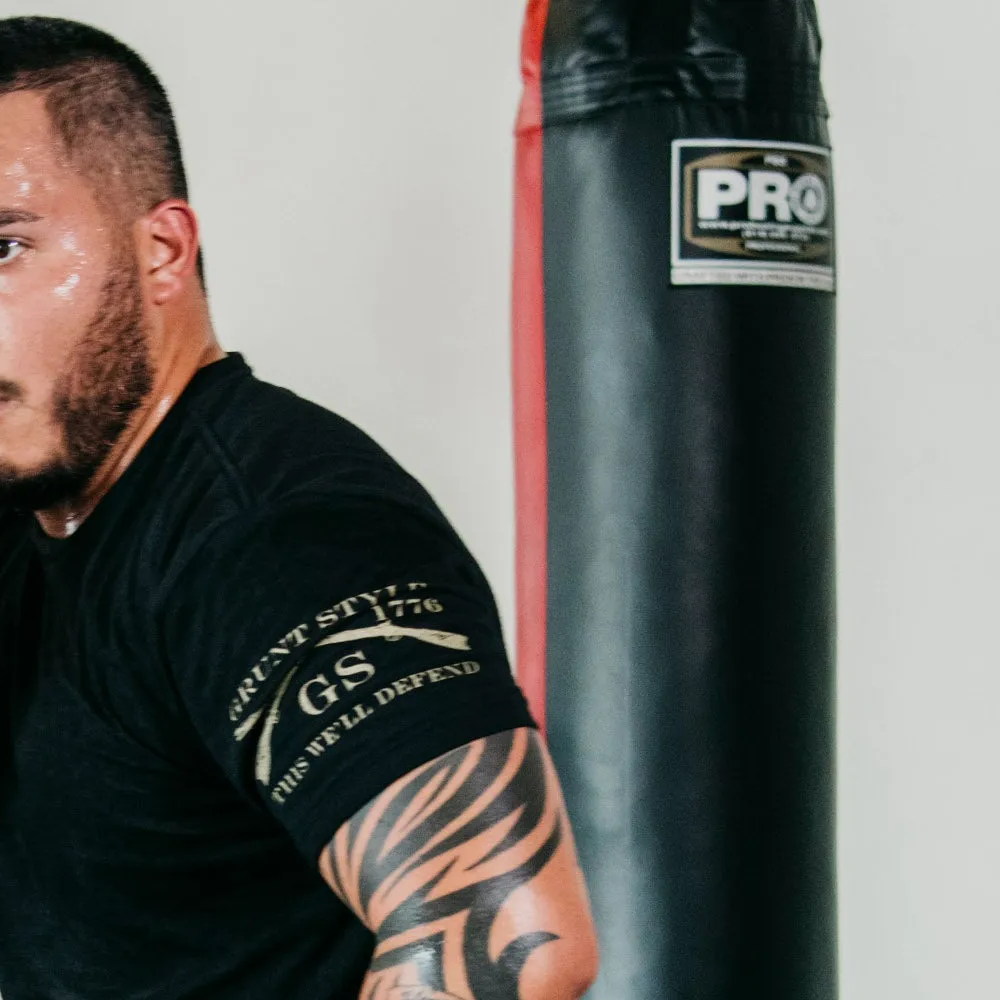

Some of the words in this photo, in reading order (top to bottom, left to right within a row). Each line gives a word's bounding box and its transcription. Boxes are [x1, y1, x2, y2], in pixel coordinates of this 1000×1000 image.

[697, 168, 827, 226] PRO
[370, 598, 444, 622] 1776
[297, 650, 376, 716] GS
[271, 756, 311, 804] THIS
[304, 702, 374, 758] WE'LL
[373, 660, 481, 706] DEFEND
